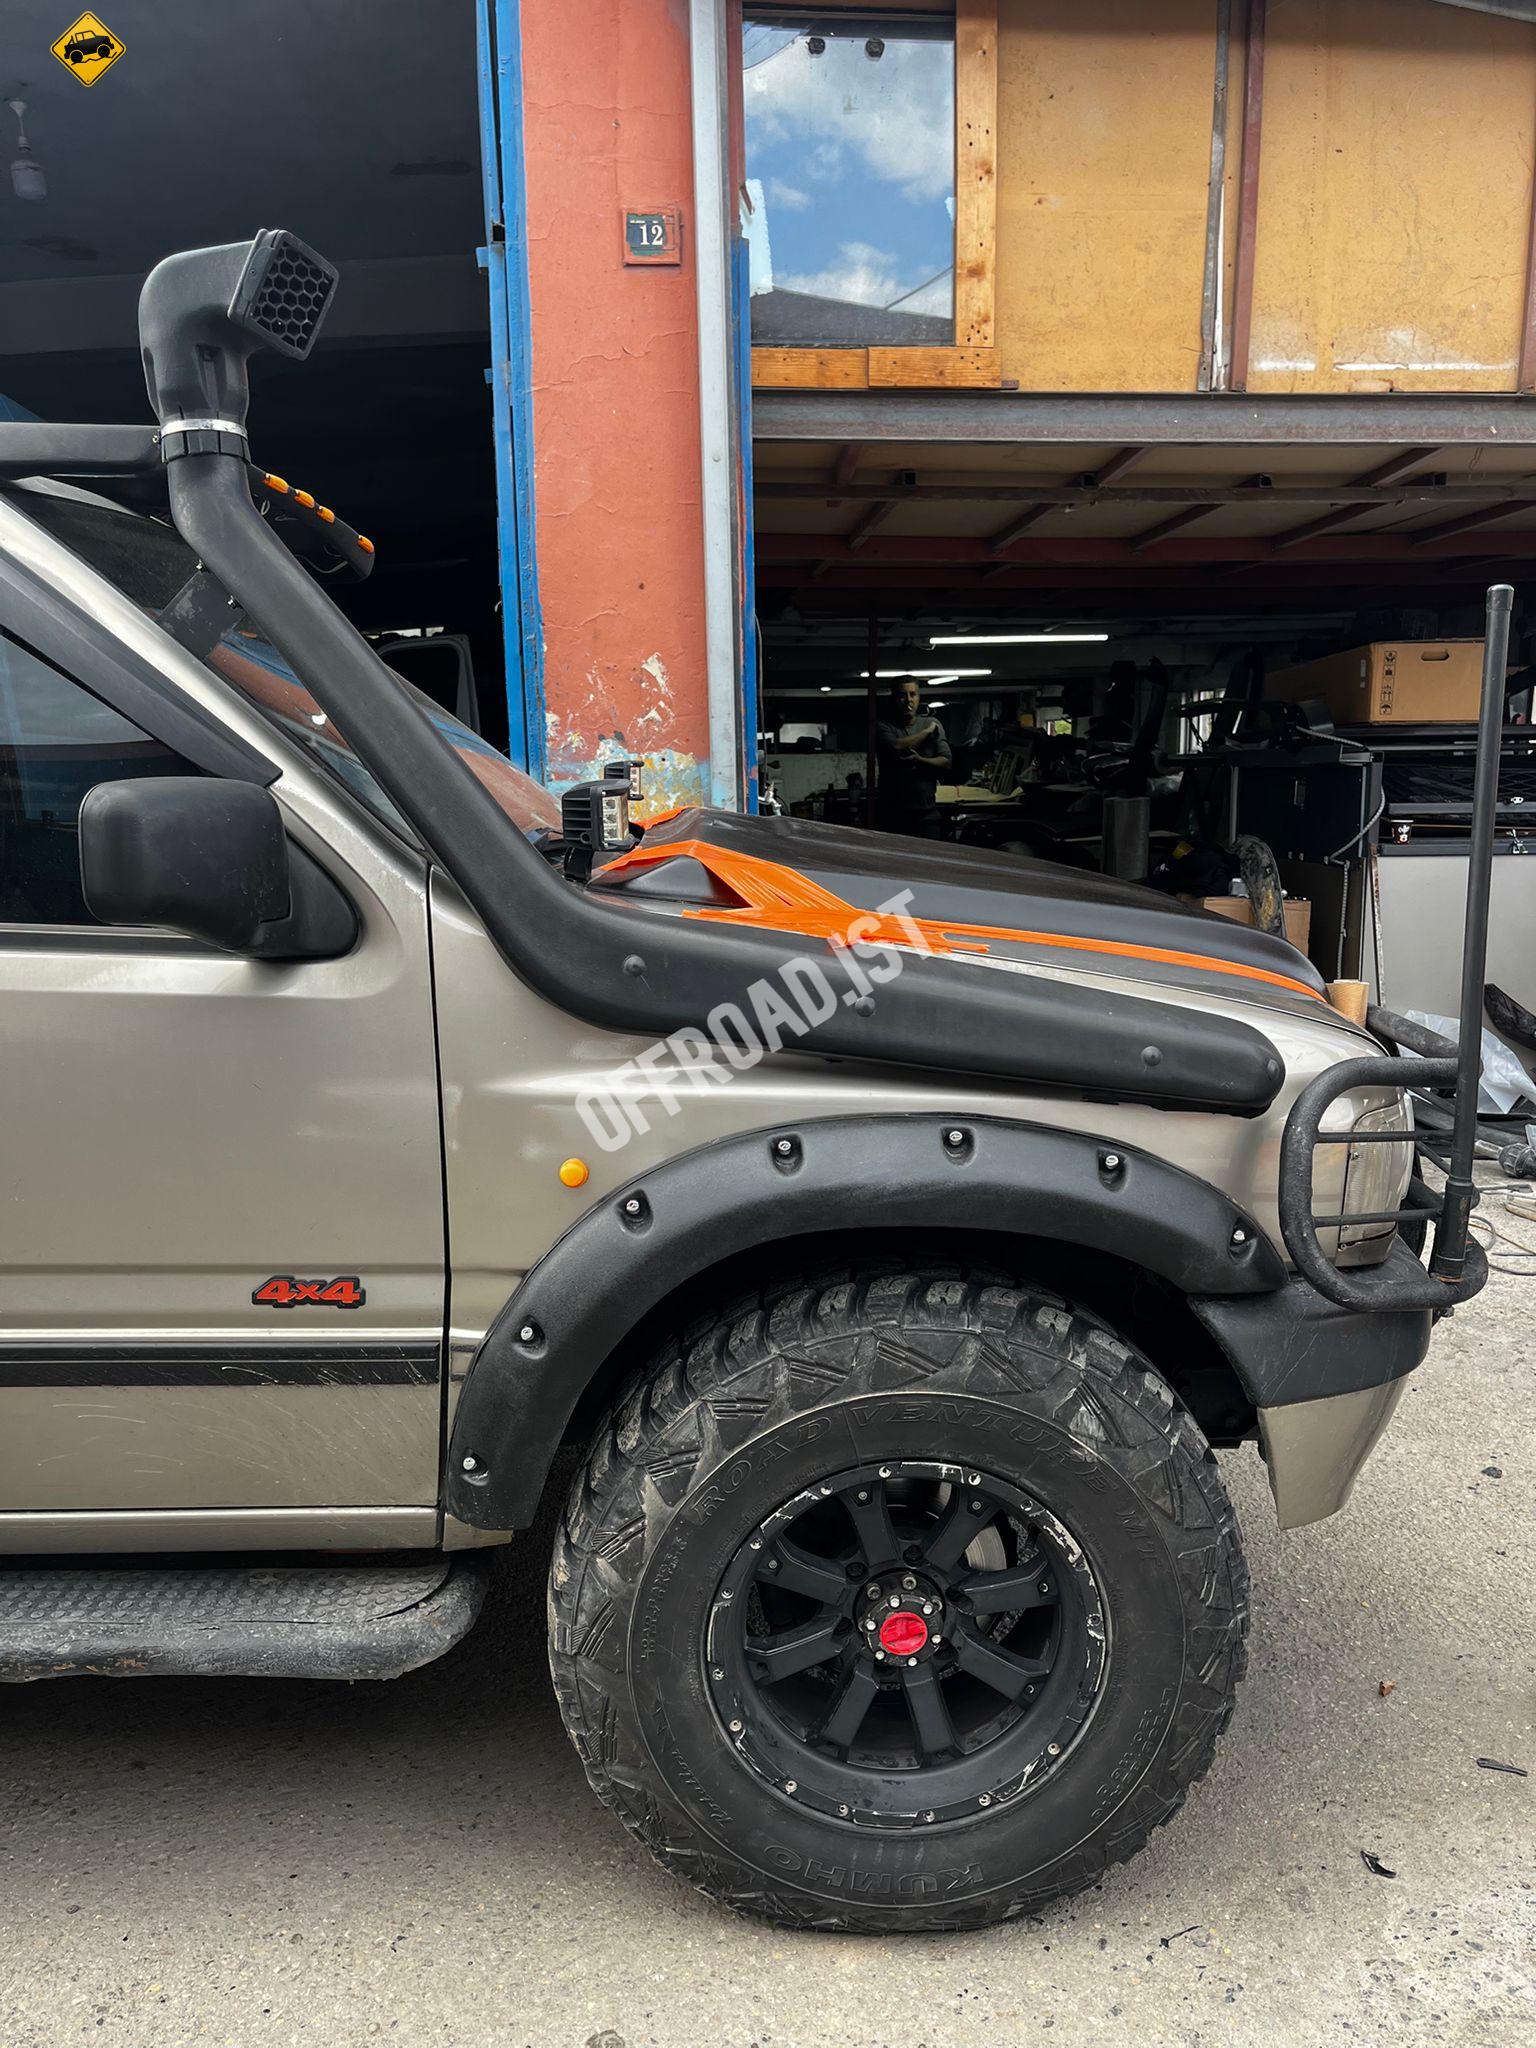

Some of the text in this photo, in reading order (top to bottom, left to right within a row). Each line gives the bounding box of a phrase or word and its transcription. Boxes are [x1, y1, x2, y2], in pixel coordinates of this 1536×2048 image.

[639, 224, 664, 246] 12
[255, 1279, 361, 1304] 4x4
[688, 1415, 832, 1527] ROAD
[850, 1399, 1121, 1496] VENTURE
[1115, 1510, 1161, 1567] MT
[763, 1844, 985, 1896] KUMHO
